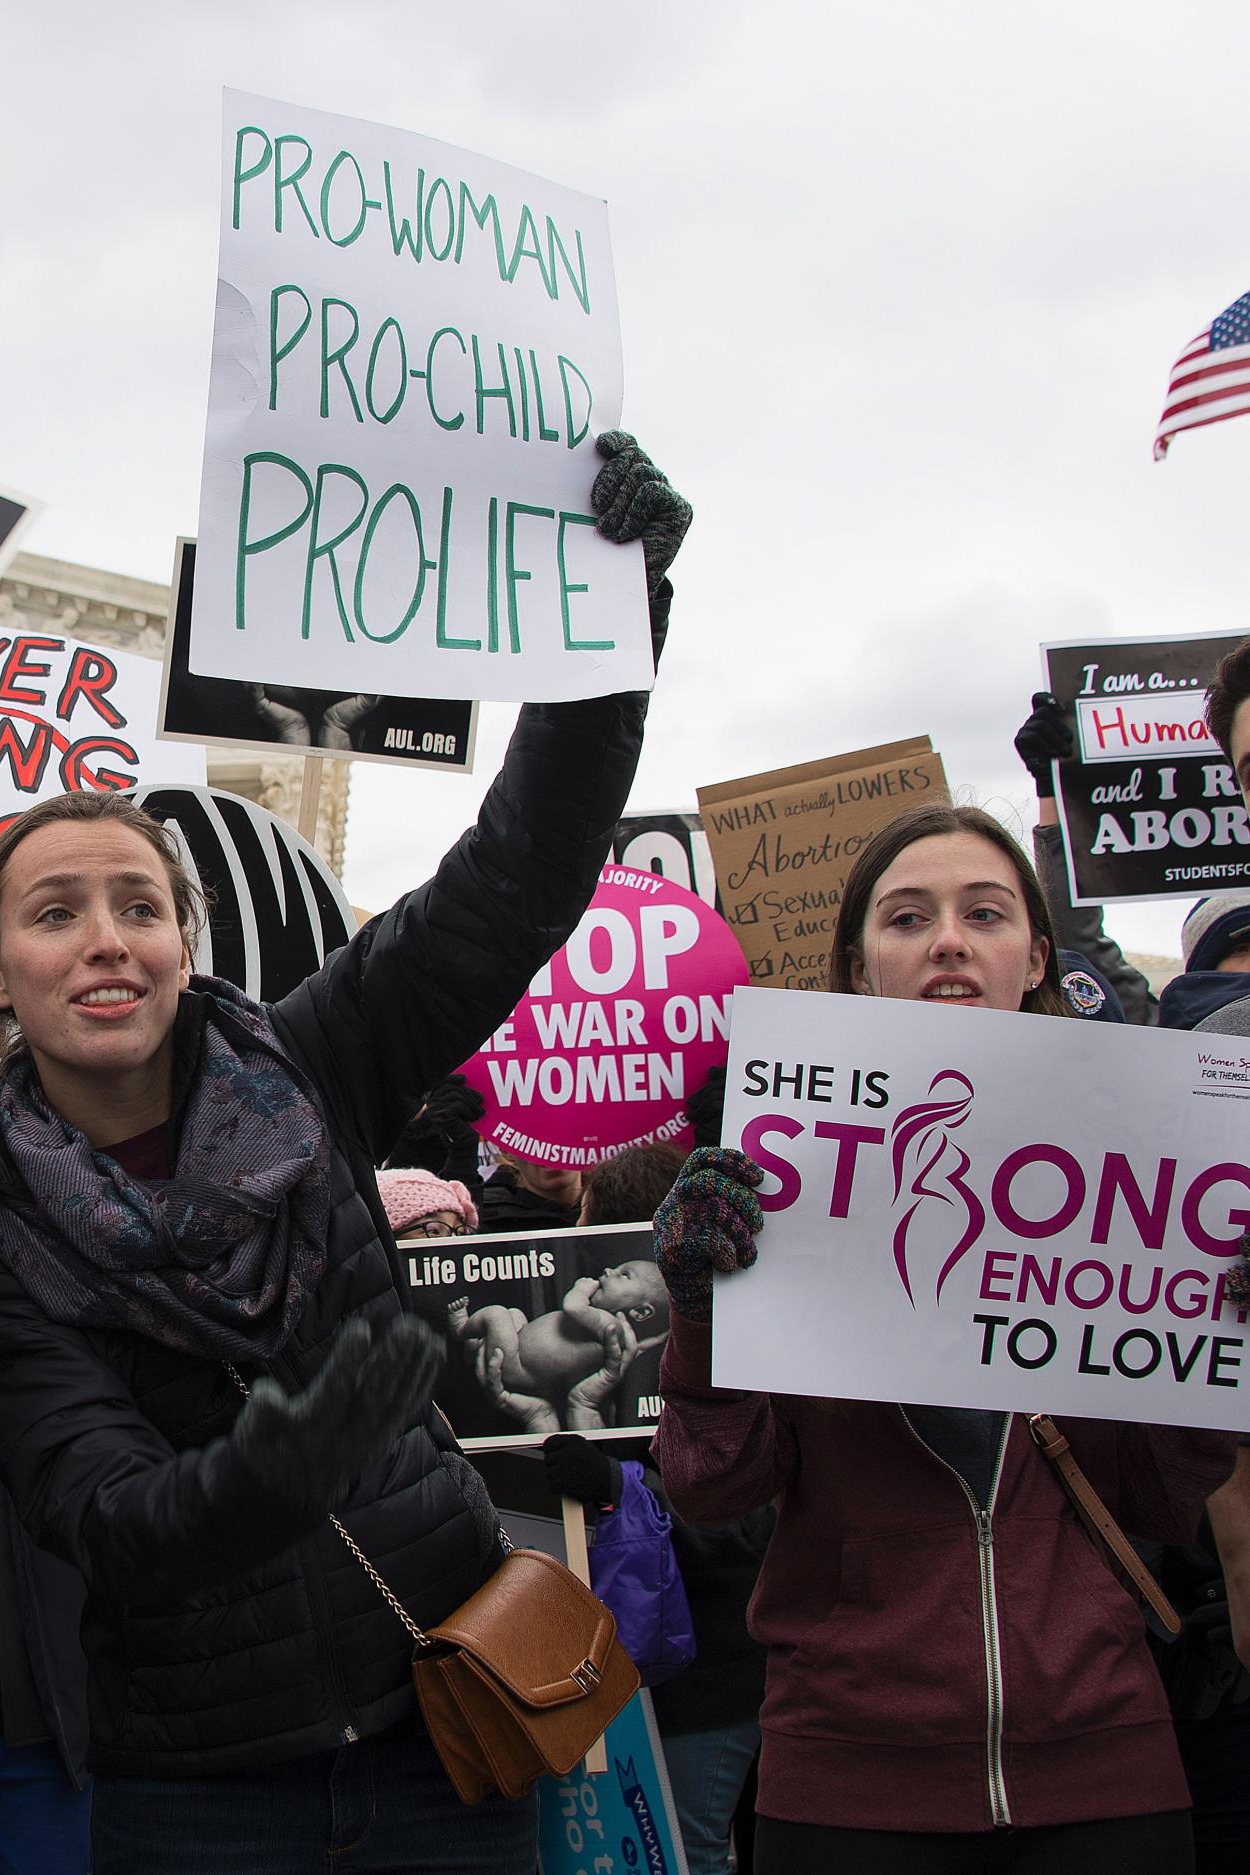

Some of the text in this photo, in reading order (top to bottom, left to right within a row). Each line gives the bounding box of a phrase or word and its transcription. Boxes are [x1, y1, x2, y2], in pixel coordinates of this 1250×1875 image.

[231, 126, 591, 315] PRO-WOMAN
[268, 284, 593, 449] PRO-CHILD
[235, 451, 616, 654] PRO-LIFE
[1079, 663, 1099, 695] I
[1103, 673, 1144, 693] am
[384, 727, 456, 756] AUL.ORG
[710, 766, 931, 835] WHAT actually LOWERS
[1091, 764, 1243, 805] and I R
[531, 999, 646, 1050] WAR
[663, 994, 730, 1045] ON
[487, 1052, 685, 1107] WOMEN
[742, 1059, 891, 1110] SHE IS
[1197, 1053, 1235, 1068] Women
[1201, 1069, 1217, 1080] FOR
[408, 1249, 556, 1287] Life Counts
[972, 1314, 1245, 1388] TO LOVE
